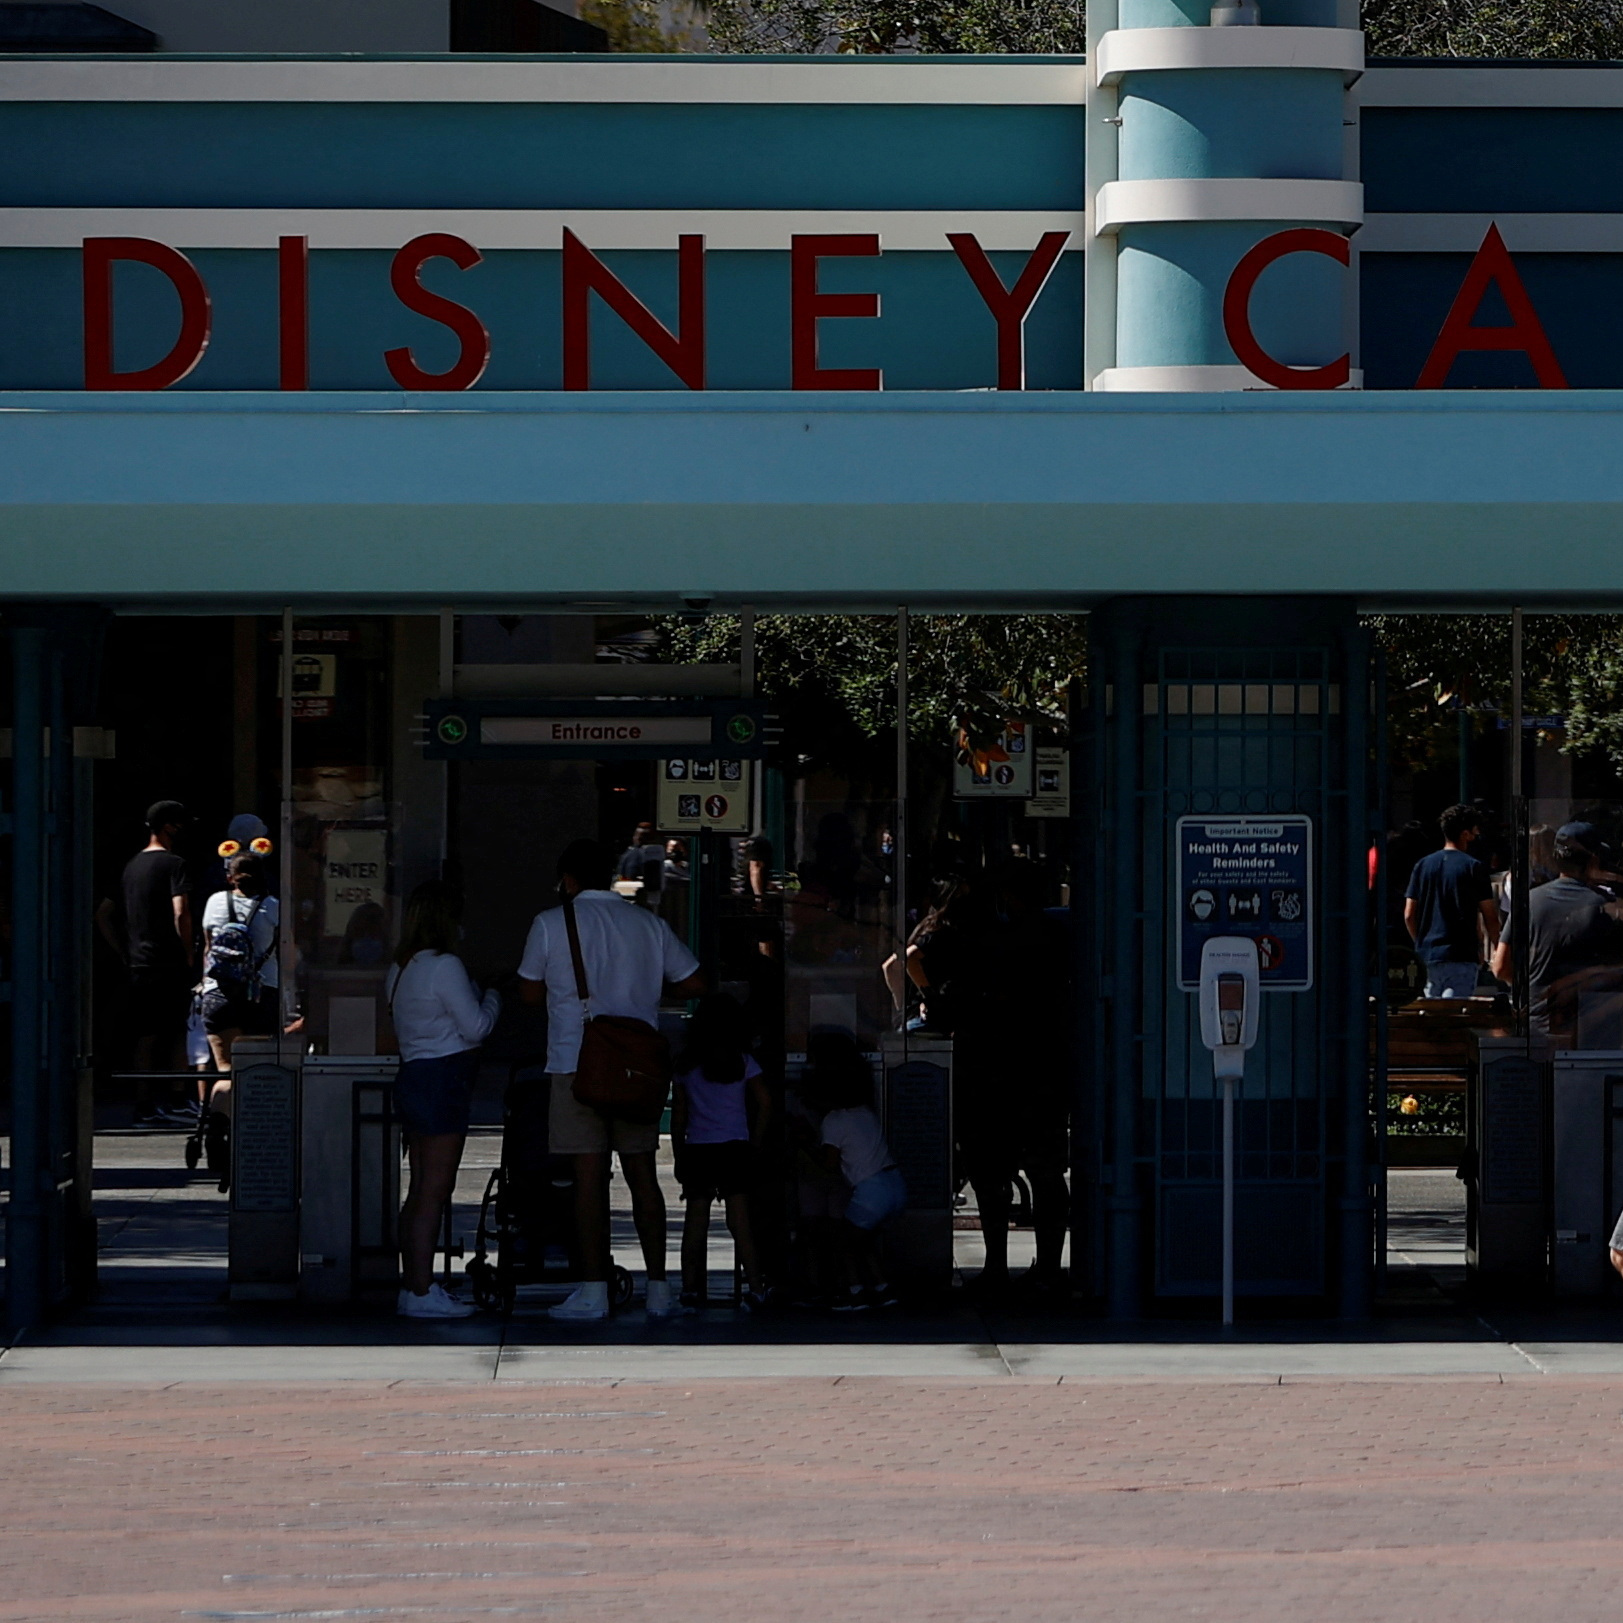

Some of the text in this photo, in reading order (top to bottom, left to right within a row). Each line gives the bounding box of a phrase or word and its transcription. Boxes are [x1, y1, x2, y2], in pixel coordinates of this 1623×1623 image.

[82, 225, 1073, 392] DISNEY
[552, 723, 641, 739] Entrance
[1189, 842, 1300, 856] Health And Safety
[329, 862, 378, 878] ENTER
[1213, 856, 1276, 869] Reminders
[335, 887, 372, 903] HERE
